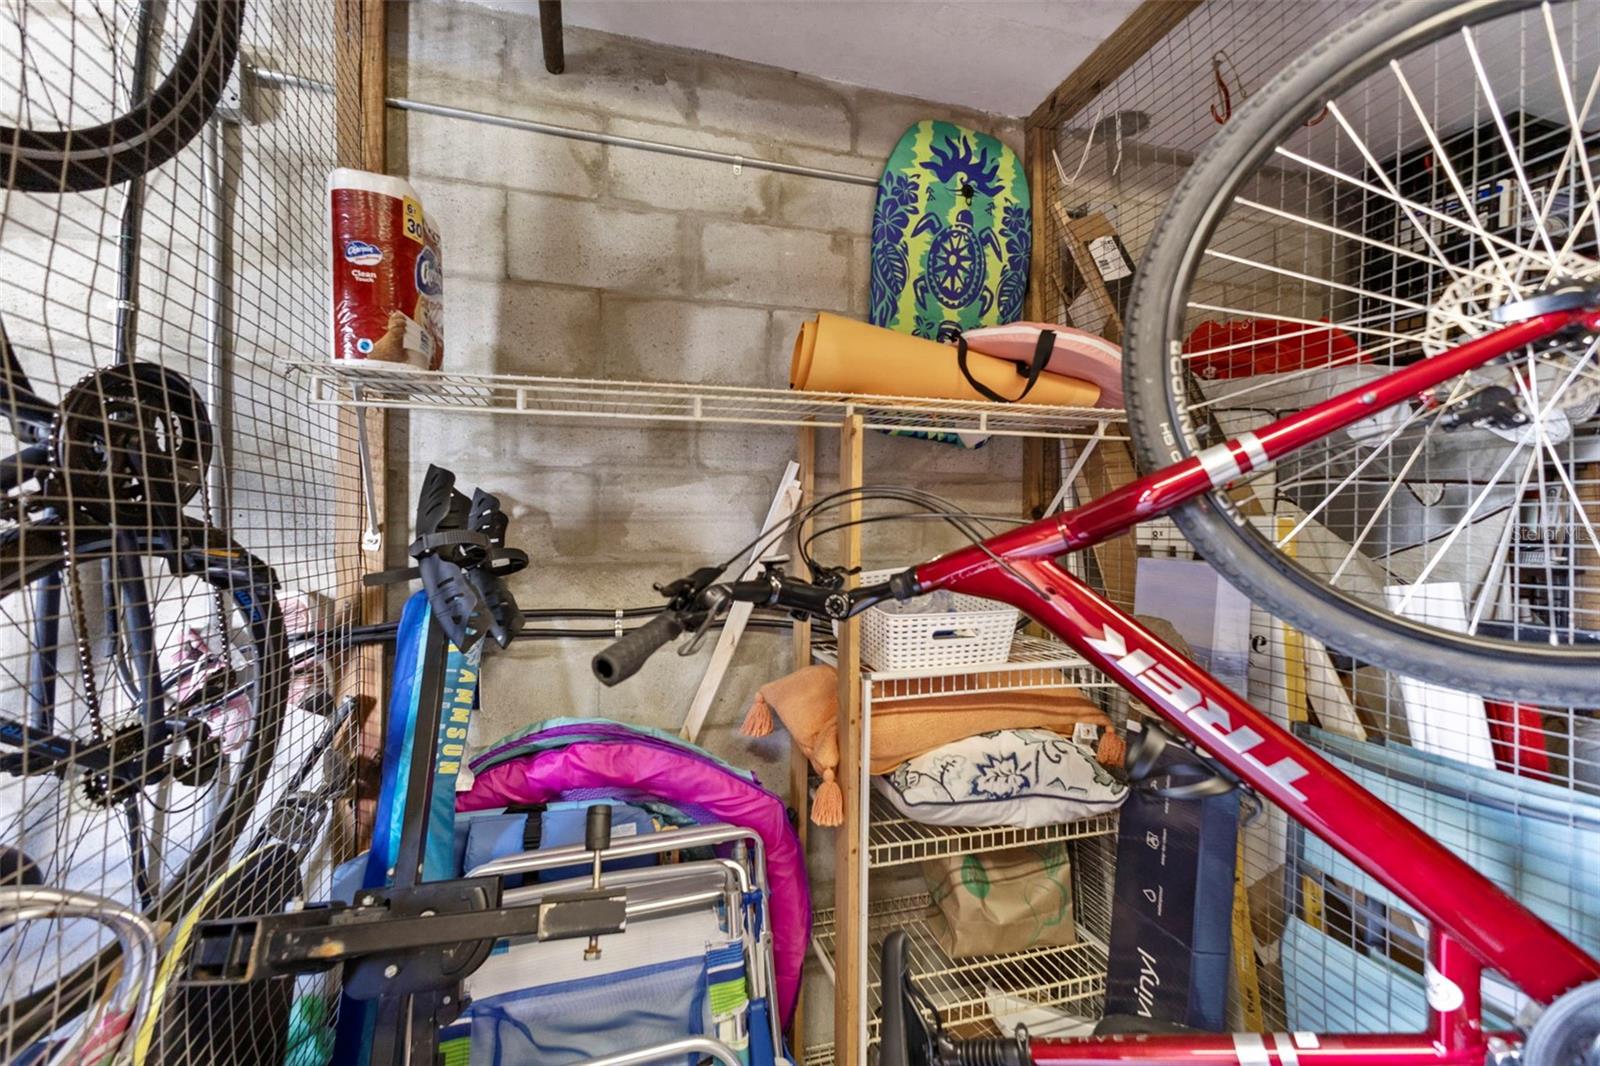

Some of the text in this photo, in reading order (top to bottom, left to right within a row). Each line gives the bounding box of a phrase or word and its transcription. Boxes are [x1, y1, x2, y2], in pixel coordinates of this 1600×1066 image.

[407, 218, 422, 238] 30
[351, 269, 377, 279] Clean
[438, 669, 477, 774] AMMSUN
[1082, 623, 1309, 802] TREK
[1133, 946, 1160, 1018] vinyl
